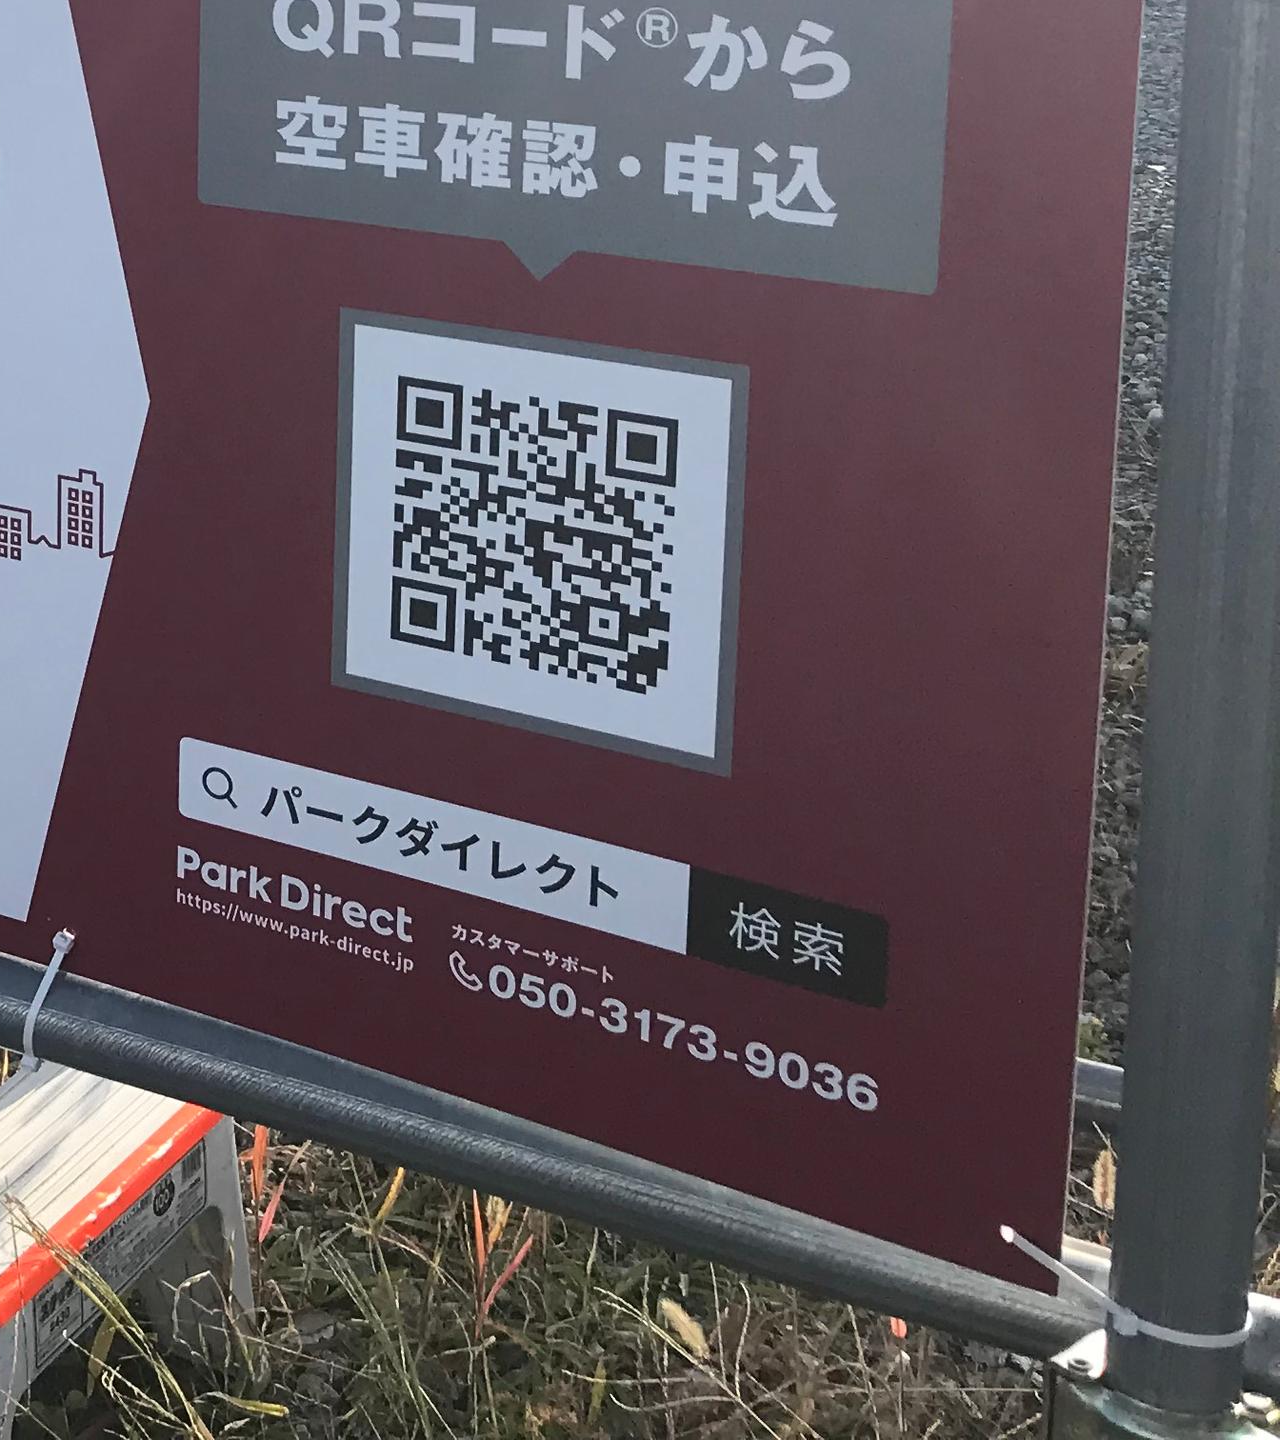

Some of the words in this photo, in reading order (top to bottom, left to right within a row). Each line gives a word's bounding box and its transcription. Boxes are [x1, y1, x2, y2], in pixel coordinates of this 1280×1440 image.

[274, 95, 839, 228] 空車確認・申込
[176, 845, 273, 904] Park
[280, 873, 414, 943] Direct
[260, 782, 620, 908] パークダイレクト
[176, 888, 415, 974] https://www.park-direct.jp
[451, 923, 614, 984] カスタマーサポート
[728, 901, 845, 977] 検索
[487, 964, 879, 1112] 050-3173-9036
